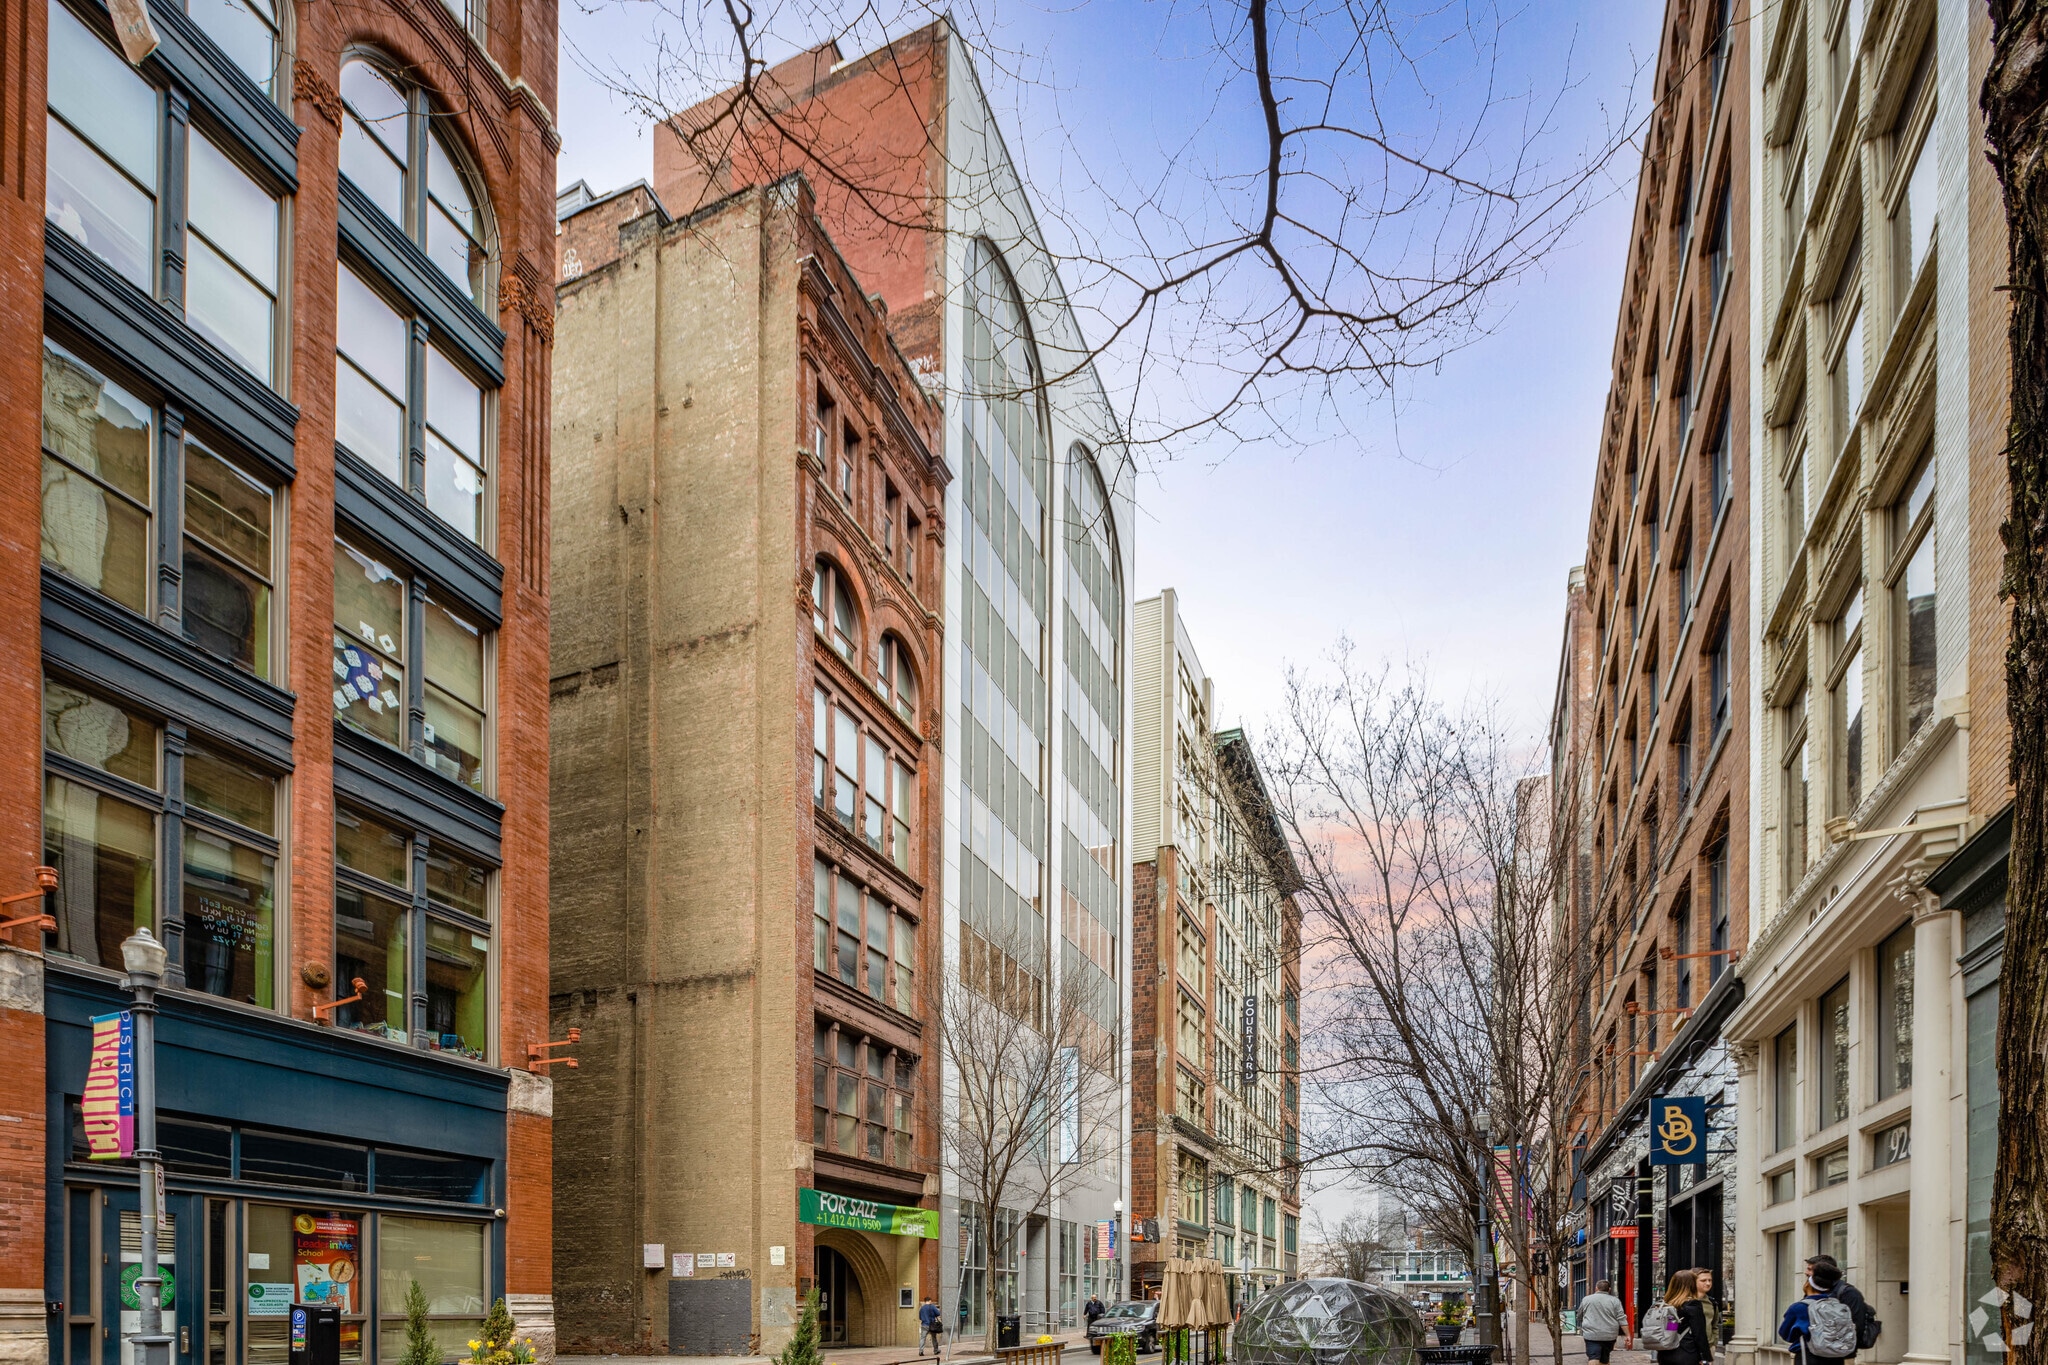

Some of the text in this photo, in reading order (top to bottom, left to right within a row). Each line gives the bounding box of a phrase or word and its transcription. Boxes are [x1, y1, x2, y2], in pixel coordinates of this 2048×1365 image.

[1245, 998, 1254, 1080] COURTYARD
[120, 1010, 132, 1112] DISTRICT
[81, 1020, 121, 1154] CULTURAL
[820, 1193, 878, 1219] FOR SALE
[1612, 1184, 1629, 1218] 930
[817, 1213, 882, 1231] +1 412 471 9500
[900, 1222, 925, 1237] CBRE
[297, 1248, 324, 1256] School
